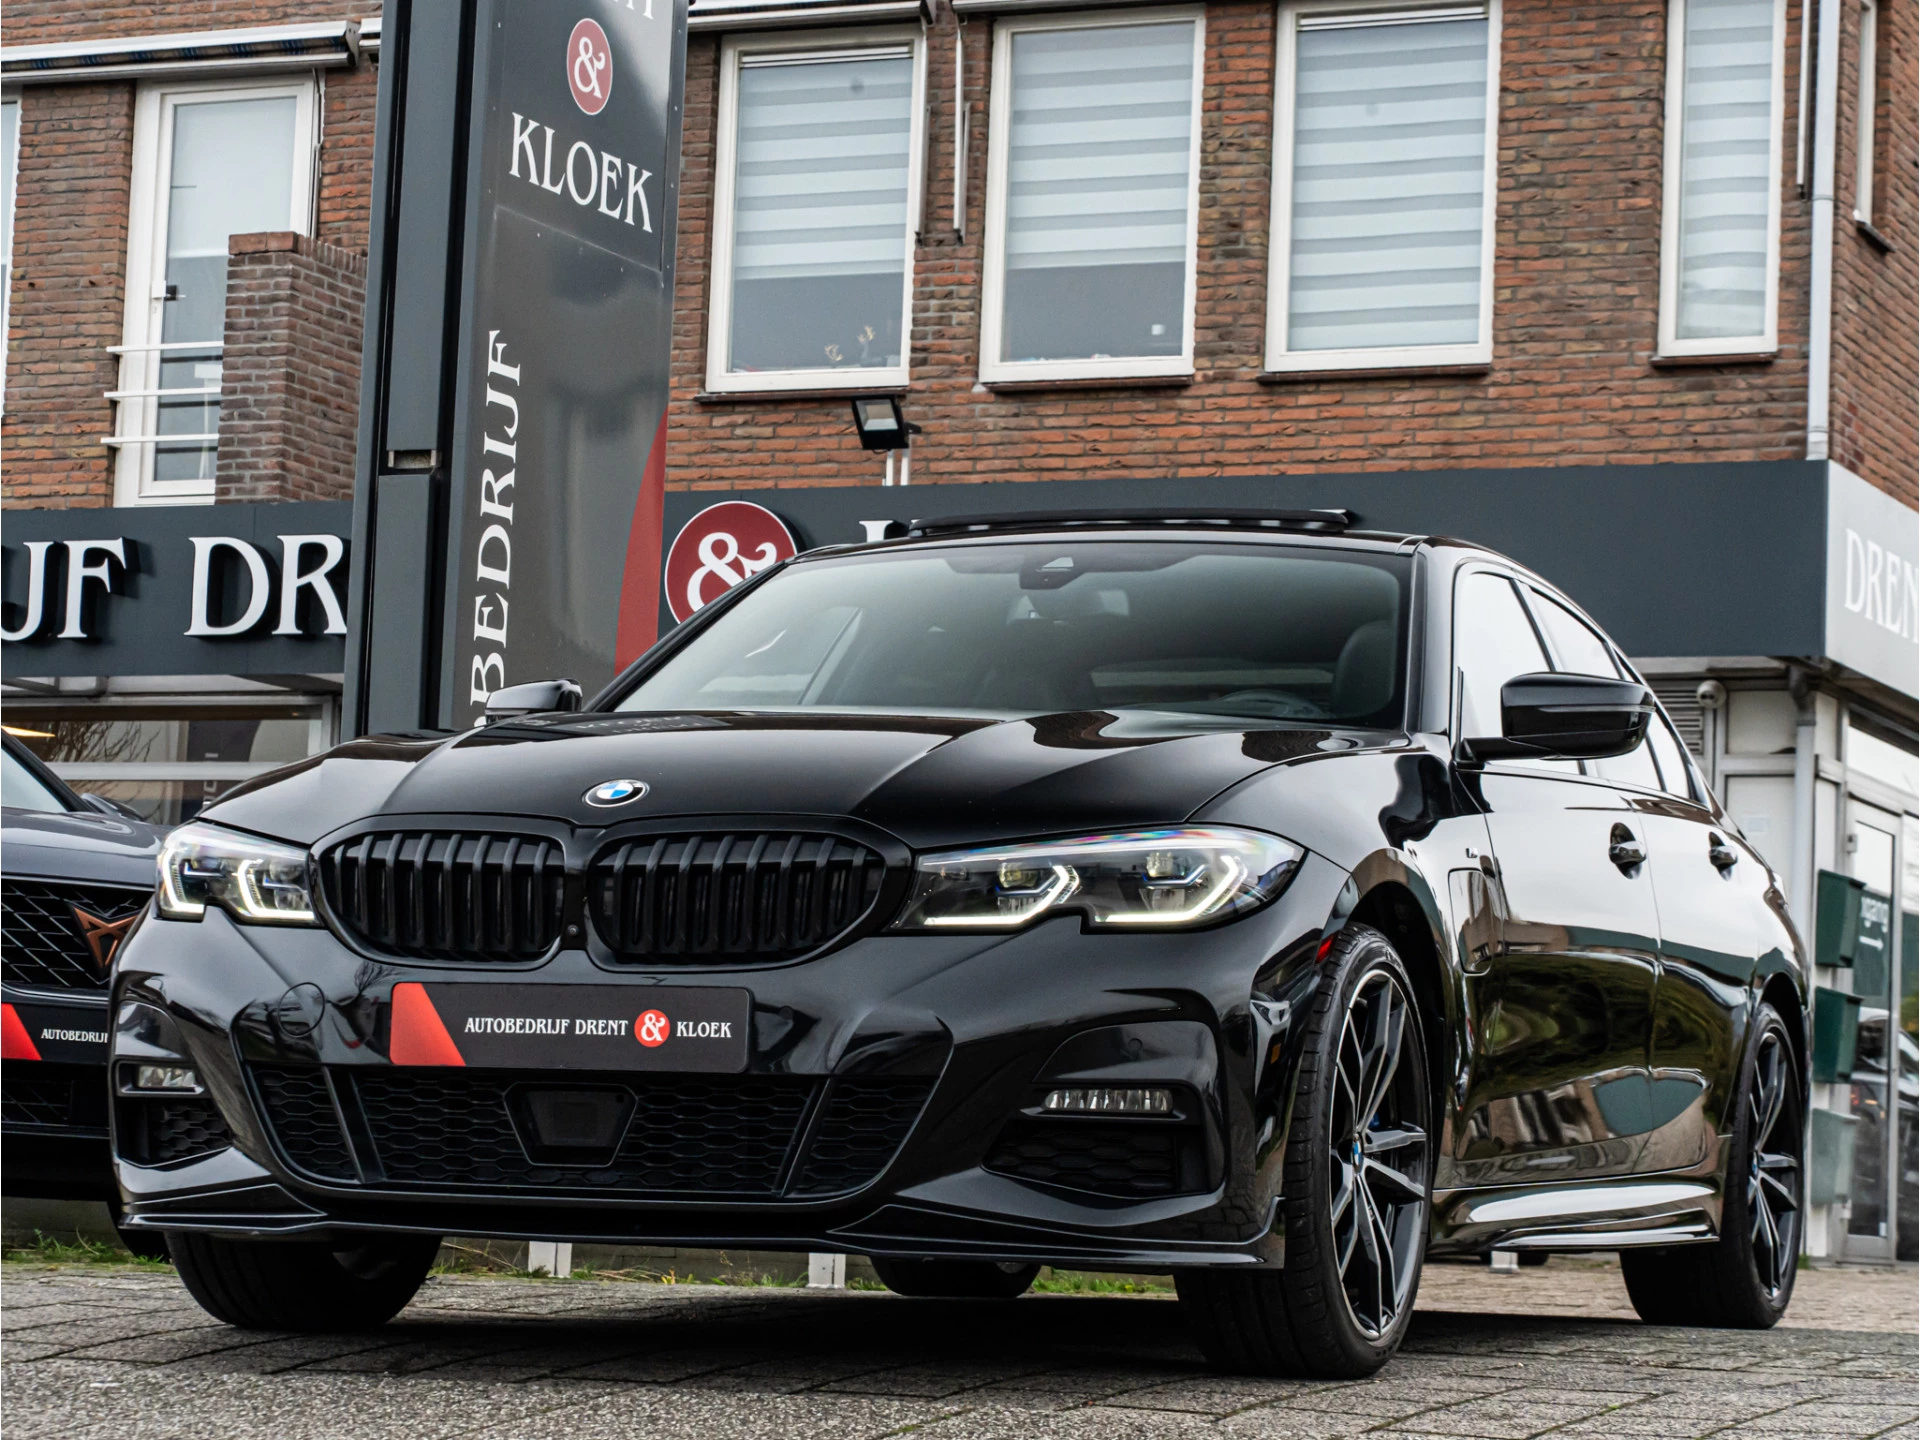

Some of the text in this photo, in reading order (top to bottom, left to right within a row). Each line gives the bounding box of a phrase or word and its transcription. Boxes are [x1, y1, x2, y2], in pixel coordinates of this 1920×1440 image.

[574, 36, 606, 99] &
[509, 112, 653, 233] KLOEK
[470, 330, 521, 728] BEDRIJF
[464, 1013, 732, 1041] AUTOBEDRIJF DRENT & KLOEK
